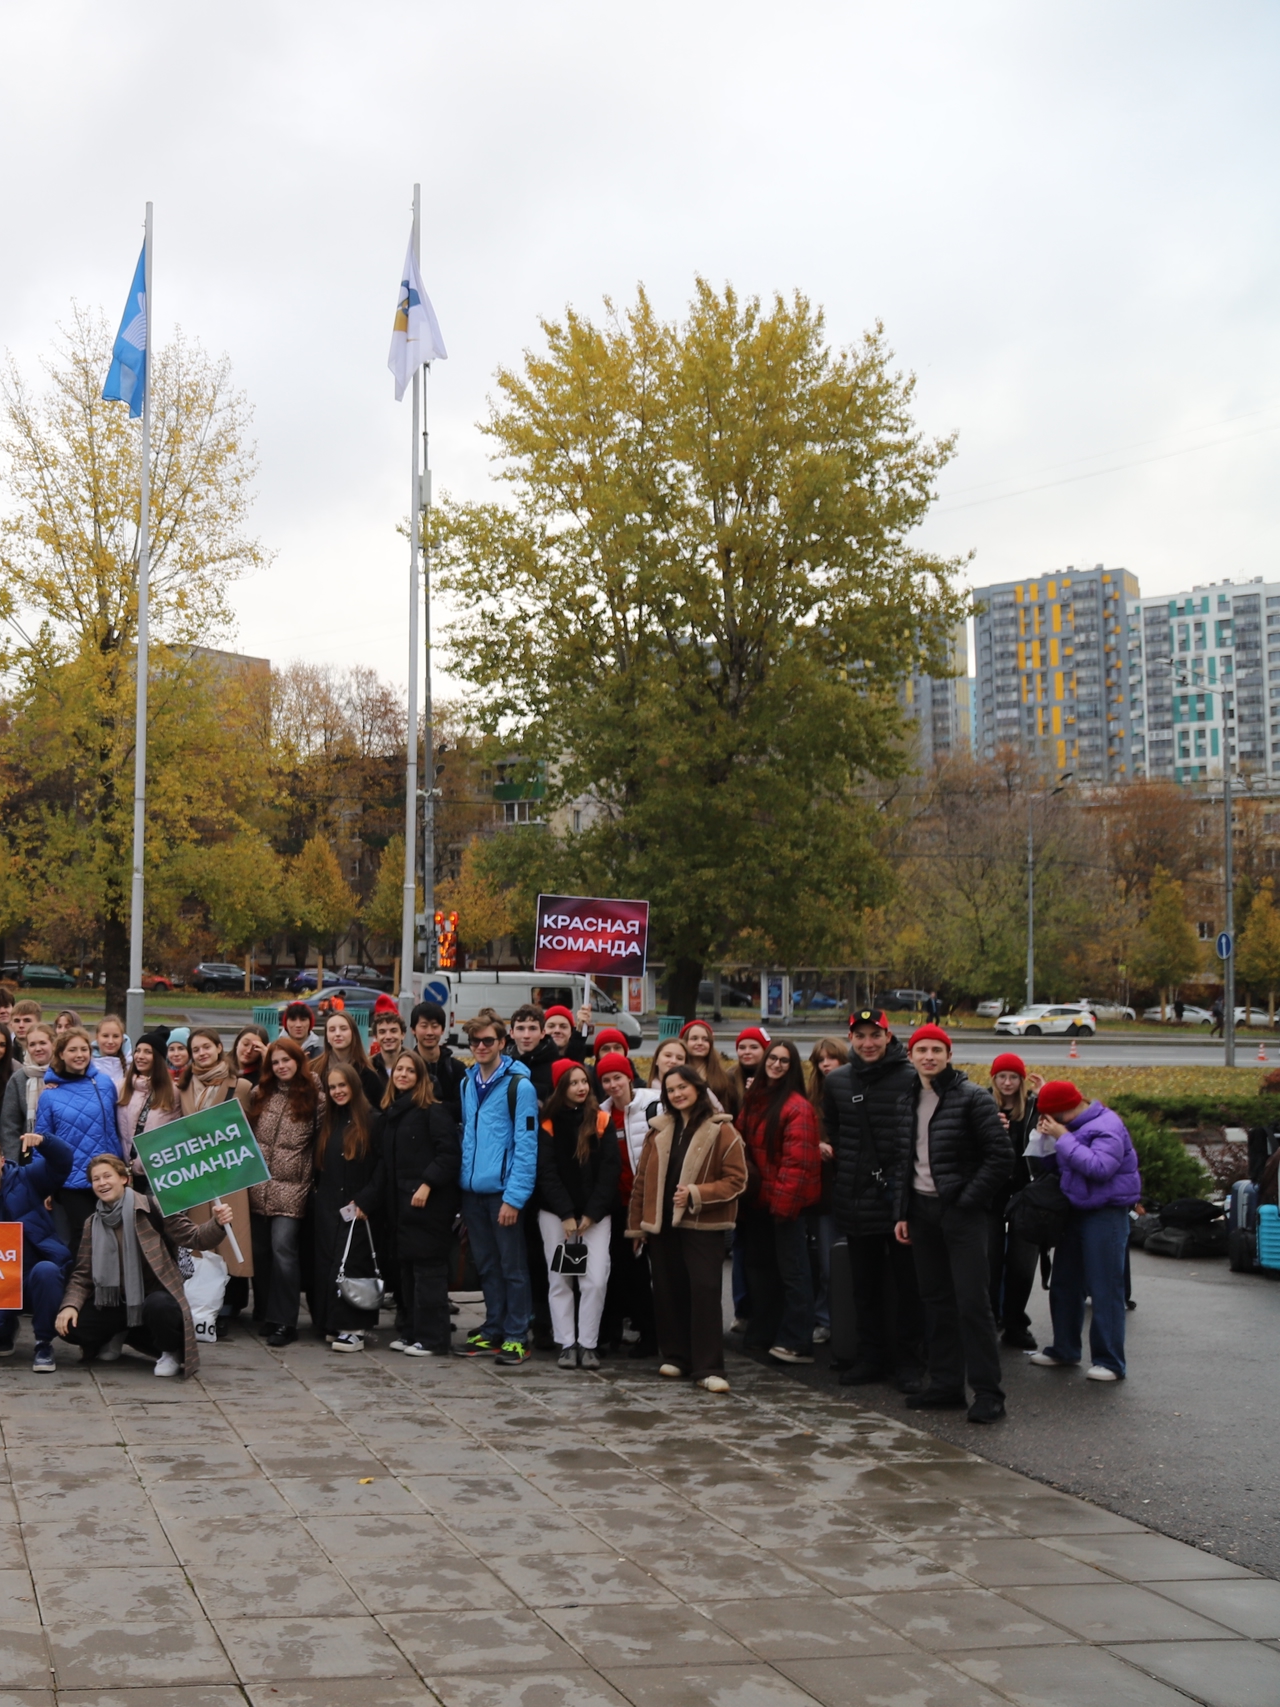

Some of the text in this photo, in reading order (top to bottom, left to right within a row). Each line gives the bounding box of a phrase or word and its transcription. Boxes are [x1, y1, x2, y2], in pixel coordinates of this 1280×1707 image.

[543, 914, 640, 935] КРАСНАЯ
[540, 934, 641, 957] КОМАНДА
[149, 1123, 241, 1168] ЗЕЛЕНАЯ
[153, 1145, 255, 1192] КОМАНДА
